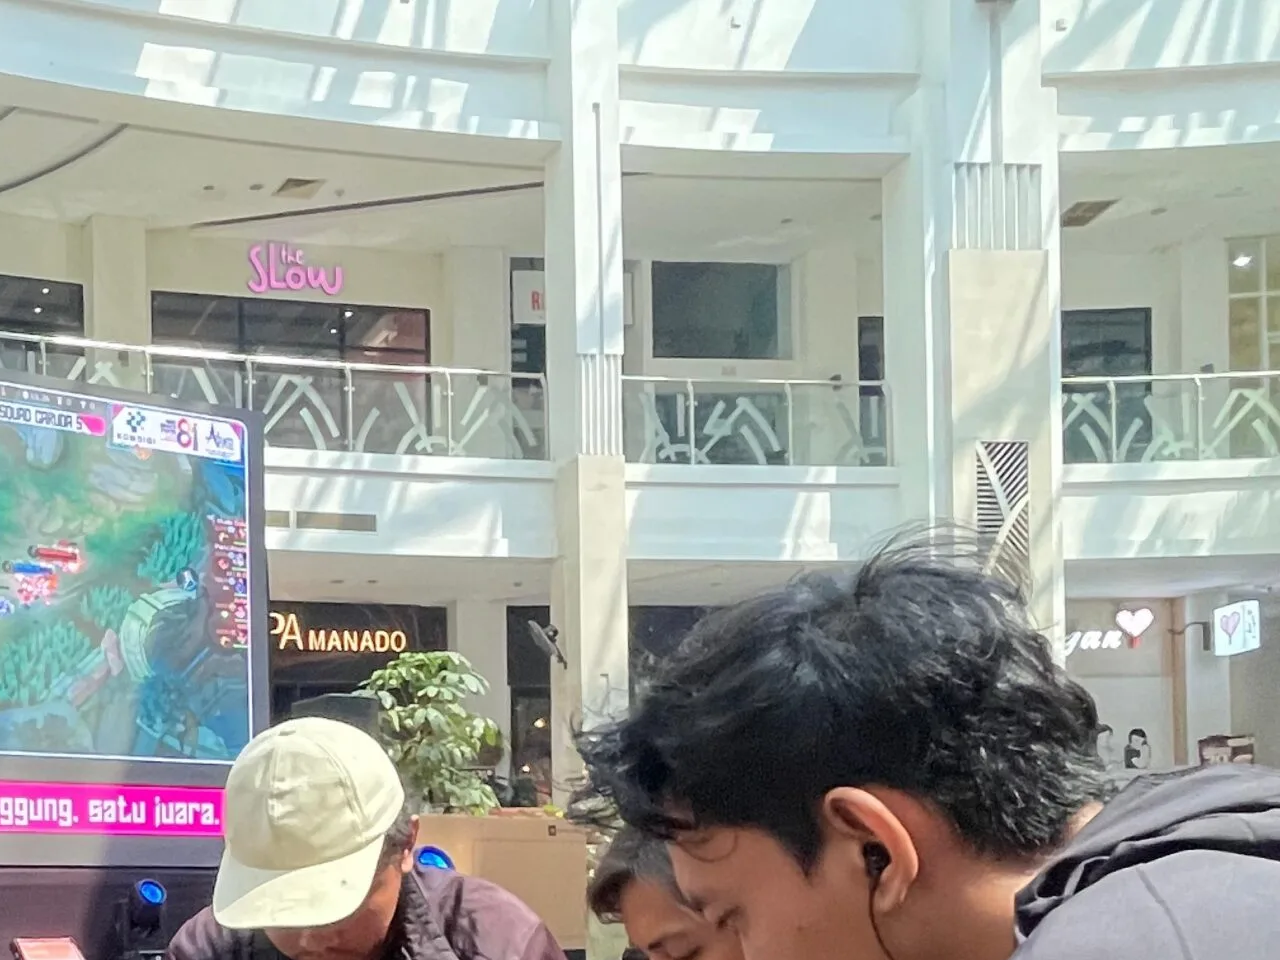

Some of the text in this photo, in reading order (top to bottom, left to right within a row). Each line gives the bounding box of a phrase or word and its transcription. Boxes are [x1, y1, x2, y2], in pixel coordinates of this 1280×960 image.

[281, 244, 304, 264] the
[308, 629, 407, 653] MANADO
[87, 794, 147, 824] satu
[154, 795, 221, 828] juara.
